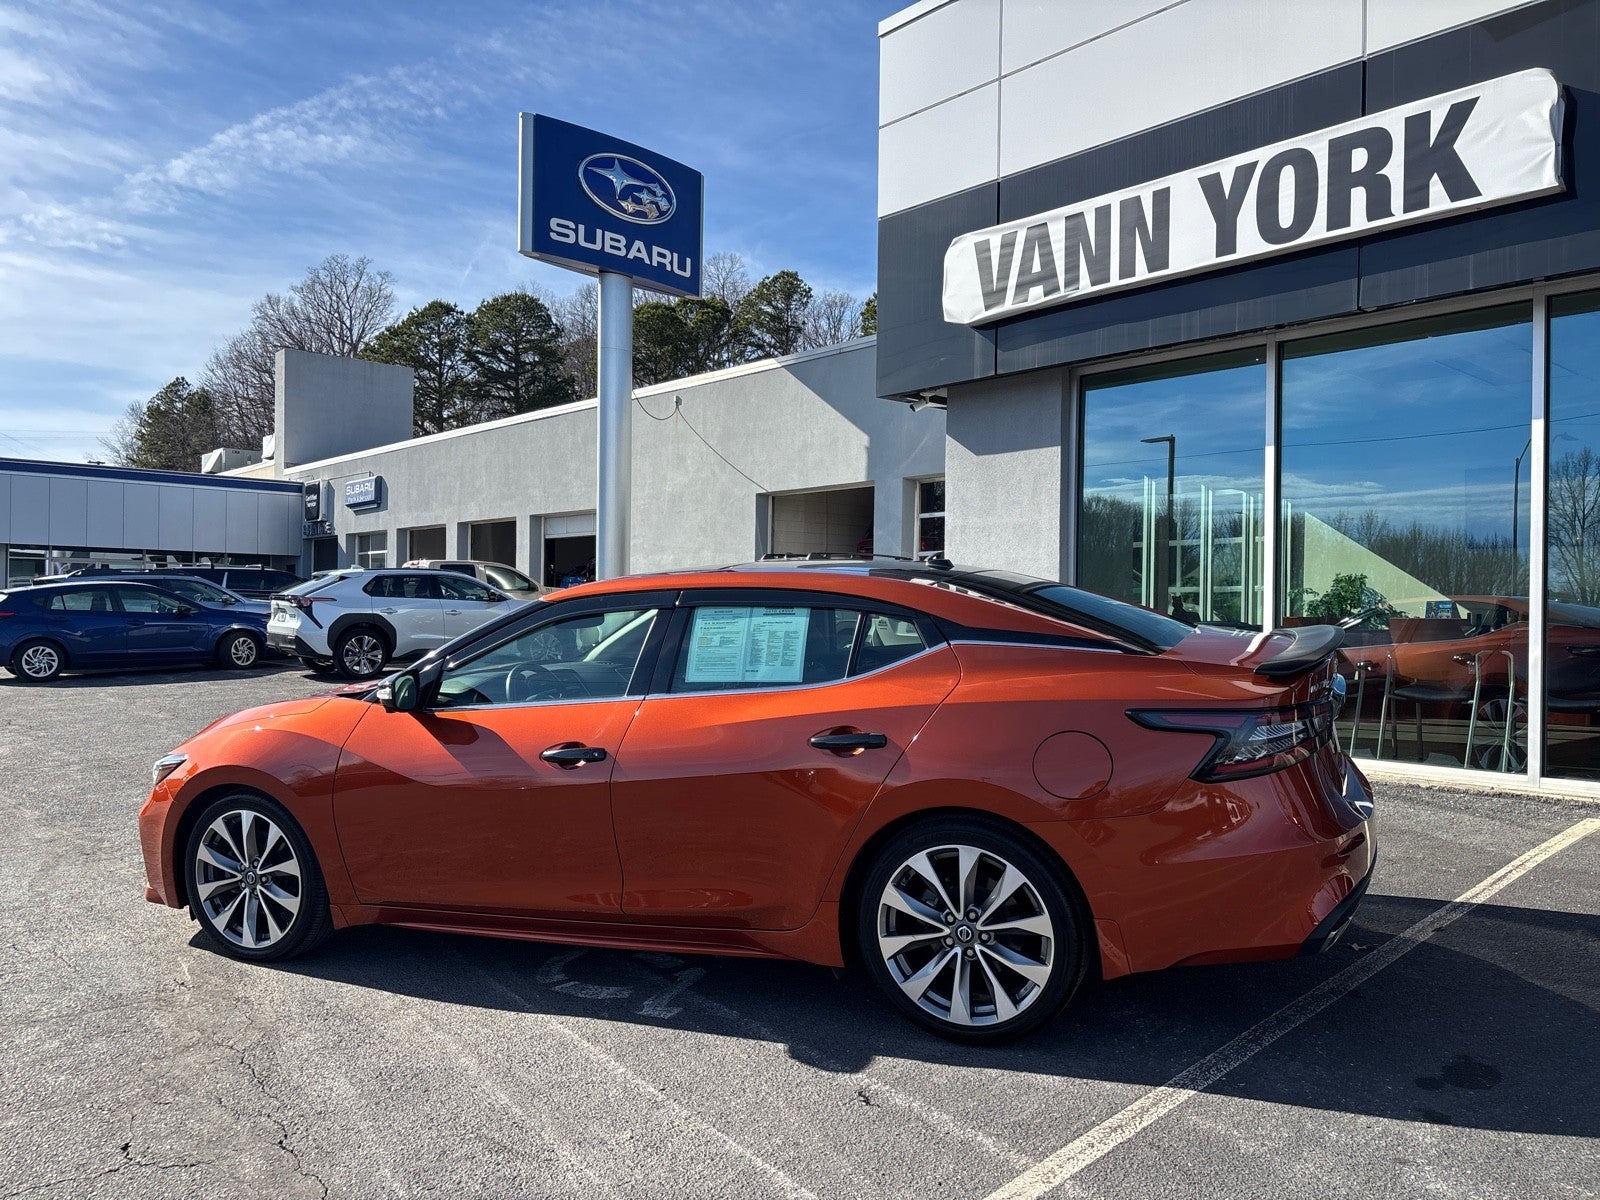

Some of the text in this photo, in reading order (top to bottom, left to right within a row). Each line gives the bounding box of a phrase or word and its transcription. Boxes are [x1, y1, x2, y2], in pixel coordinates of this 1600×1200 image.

[974, 96, 1483, 313] VANN YORK
[549, 217, 692, 278] SUBARU
[346, 481, 374, 495] SUBARU
